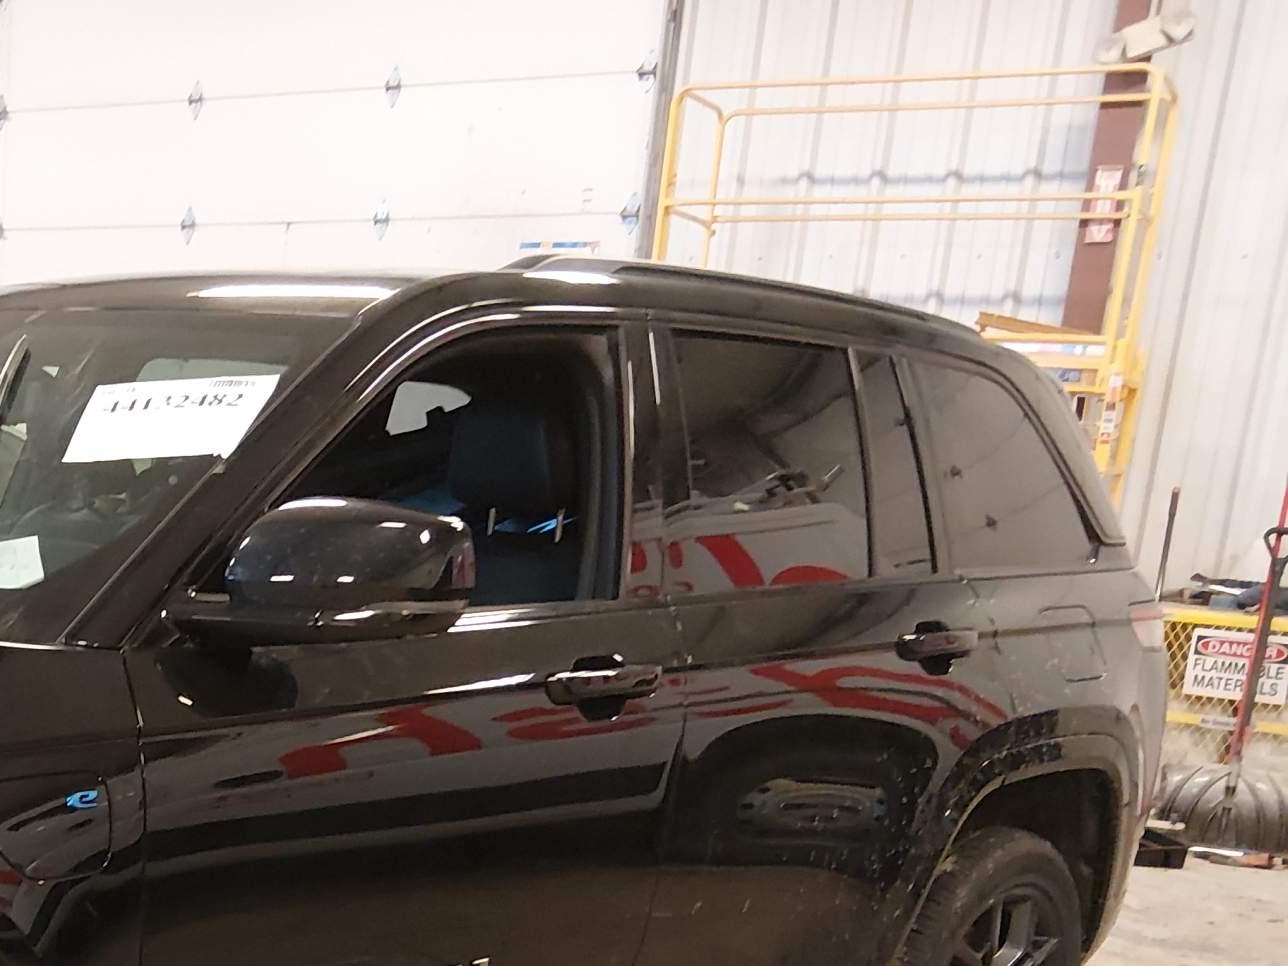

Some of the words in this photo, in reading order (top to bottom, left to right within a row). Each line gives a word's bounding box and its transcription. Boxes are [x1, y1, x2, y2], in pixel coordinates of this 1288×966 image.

[1207, 641, 1278, 659] DANGR
[1192, 658, 1286, 681] FLAMMBLE
[1192, 674, 1279, 697] MATERLS
